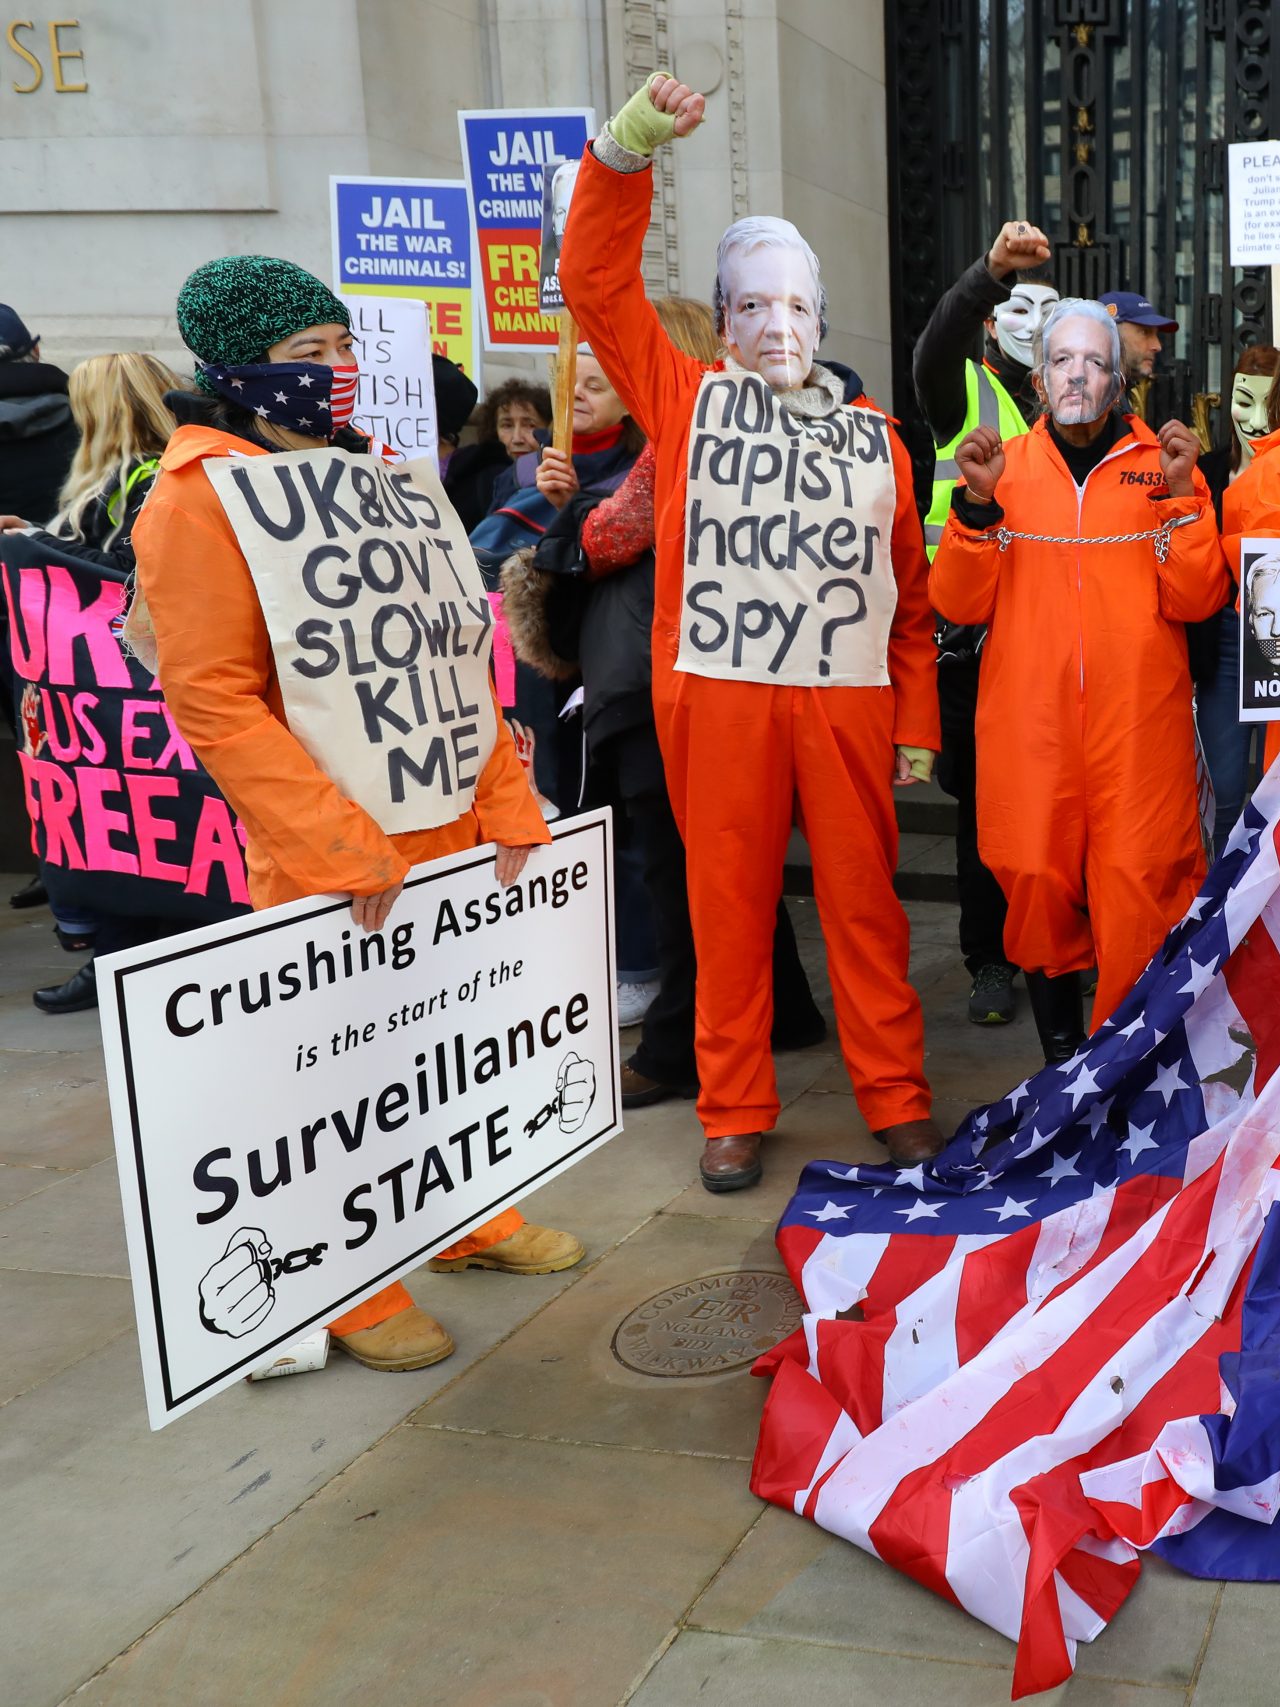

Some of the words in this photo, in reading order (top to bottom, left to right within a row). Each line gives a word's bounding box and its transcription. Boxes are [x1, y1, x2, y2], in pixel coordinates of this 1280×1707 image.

[489, 130, 566, 166] JAIL
[486, 172, 526, 192] THE
[1247, 173, 1272, 184] don't
[361, 196, 445, 230] JAIL
[479, 199, 543, 219] CRIMIN
[1244, 198, 1275, 208] Trump
[1244, 210, 1252, 218] is
[1255, 210, 1267, 218] an
[1244, 220, 1261, 231] (for
[1244, 232, 1256, 240] he
[1258, 231, 1275, 240] lies
[356, 233, 398, 253] THE
[404, 235, 453, 254] WAR
[1237, 243, 1272, 253] climate
[344, 256, 466, 279] CRIMINALS!
[487, 244, 540, 282] FR
[351, 307, 395, 334] LL
[358, 373, 423, 408] TISH
[351, 414, 430, 449] STICE
[687, 499, 881, 575] hacker
[291, 598, 493, 679] SLOWLY
[39, 688, 107, 765] US
[387, 722, 480, 803] ME
[16, 750, 190, 885] FREE
[165, 920, 416, 1038] Crushing
[432, 860, 589, 946] Assange
[296, 1044, 318, 1073] is
[331, 1019, 376, 1057] the
[387, 988, 448, 1034] start
[457, 970, 483, 1003] of
[488, 956, 524, 988] the
[192, 992, 589, 1225] Surveillance
[342, 1104, 513, 1251] STATE
